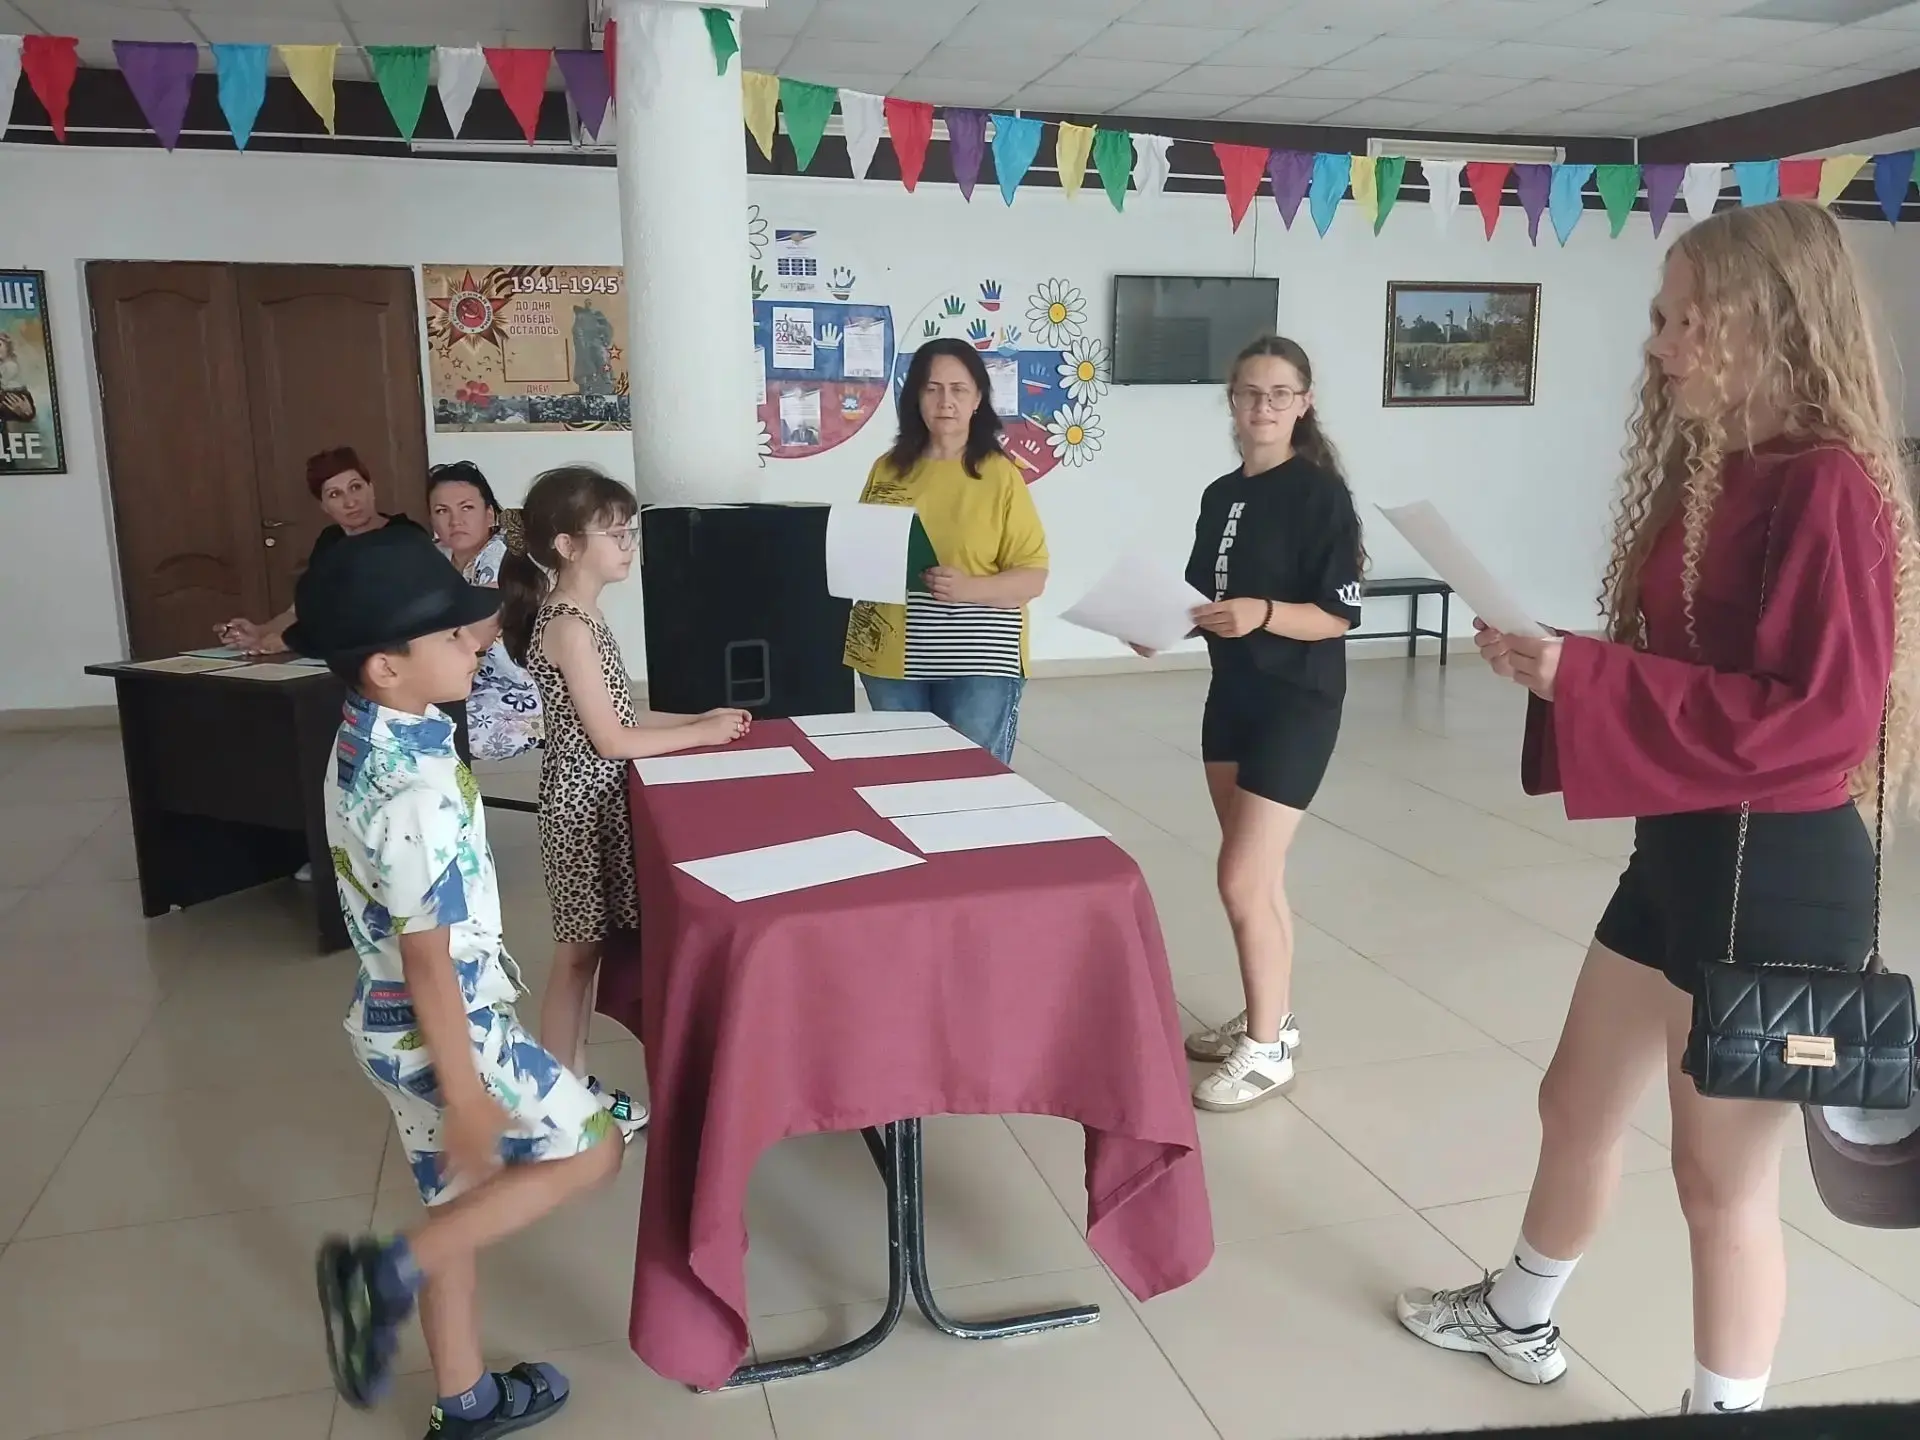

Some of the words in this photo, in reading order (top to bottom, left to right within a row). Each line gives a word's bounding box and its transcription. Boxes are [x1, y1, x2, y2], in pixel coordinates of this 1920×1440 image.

[511, 276, 619, 294] 1941-1945
[516, 301, 528, 311] ДО
[532, 301, 551, 311] ДНЯ
[513, 314, 554, 325] ПОБЕДЫ
[510, 326, 559, 335] ОСТАЛОСЬ
